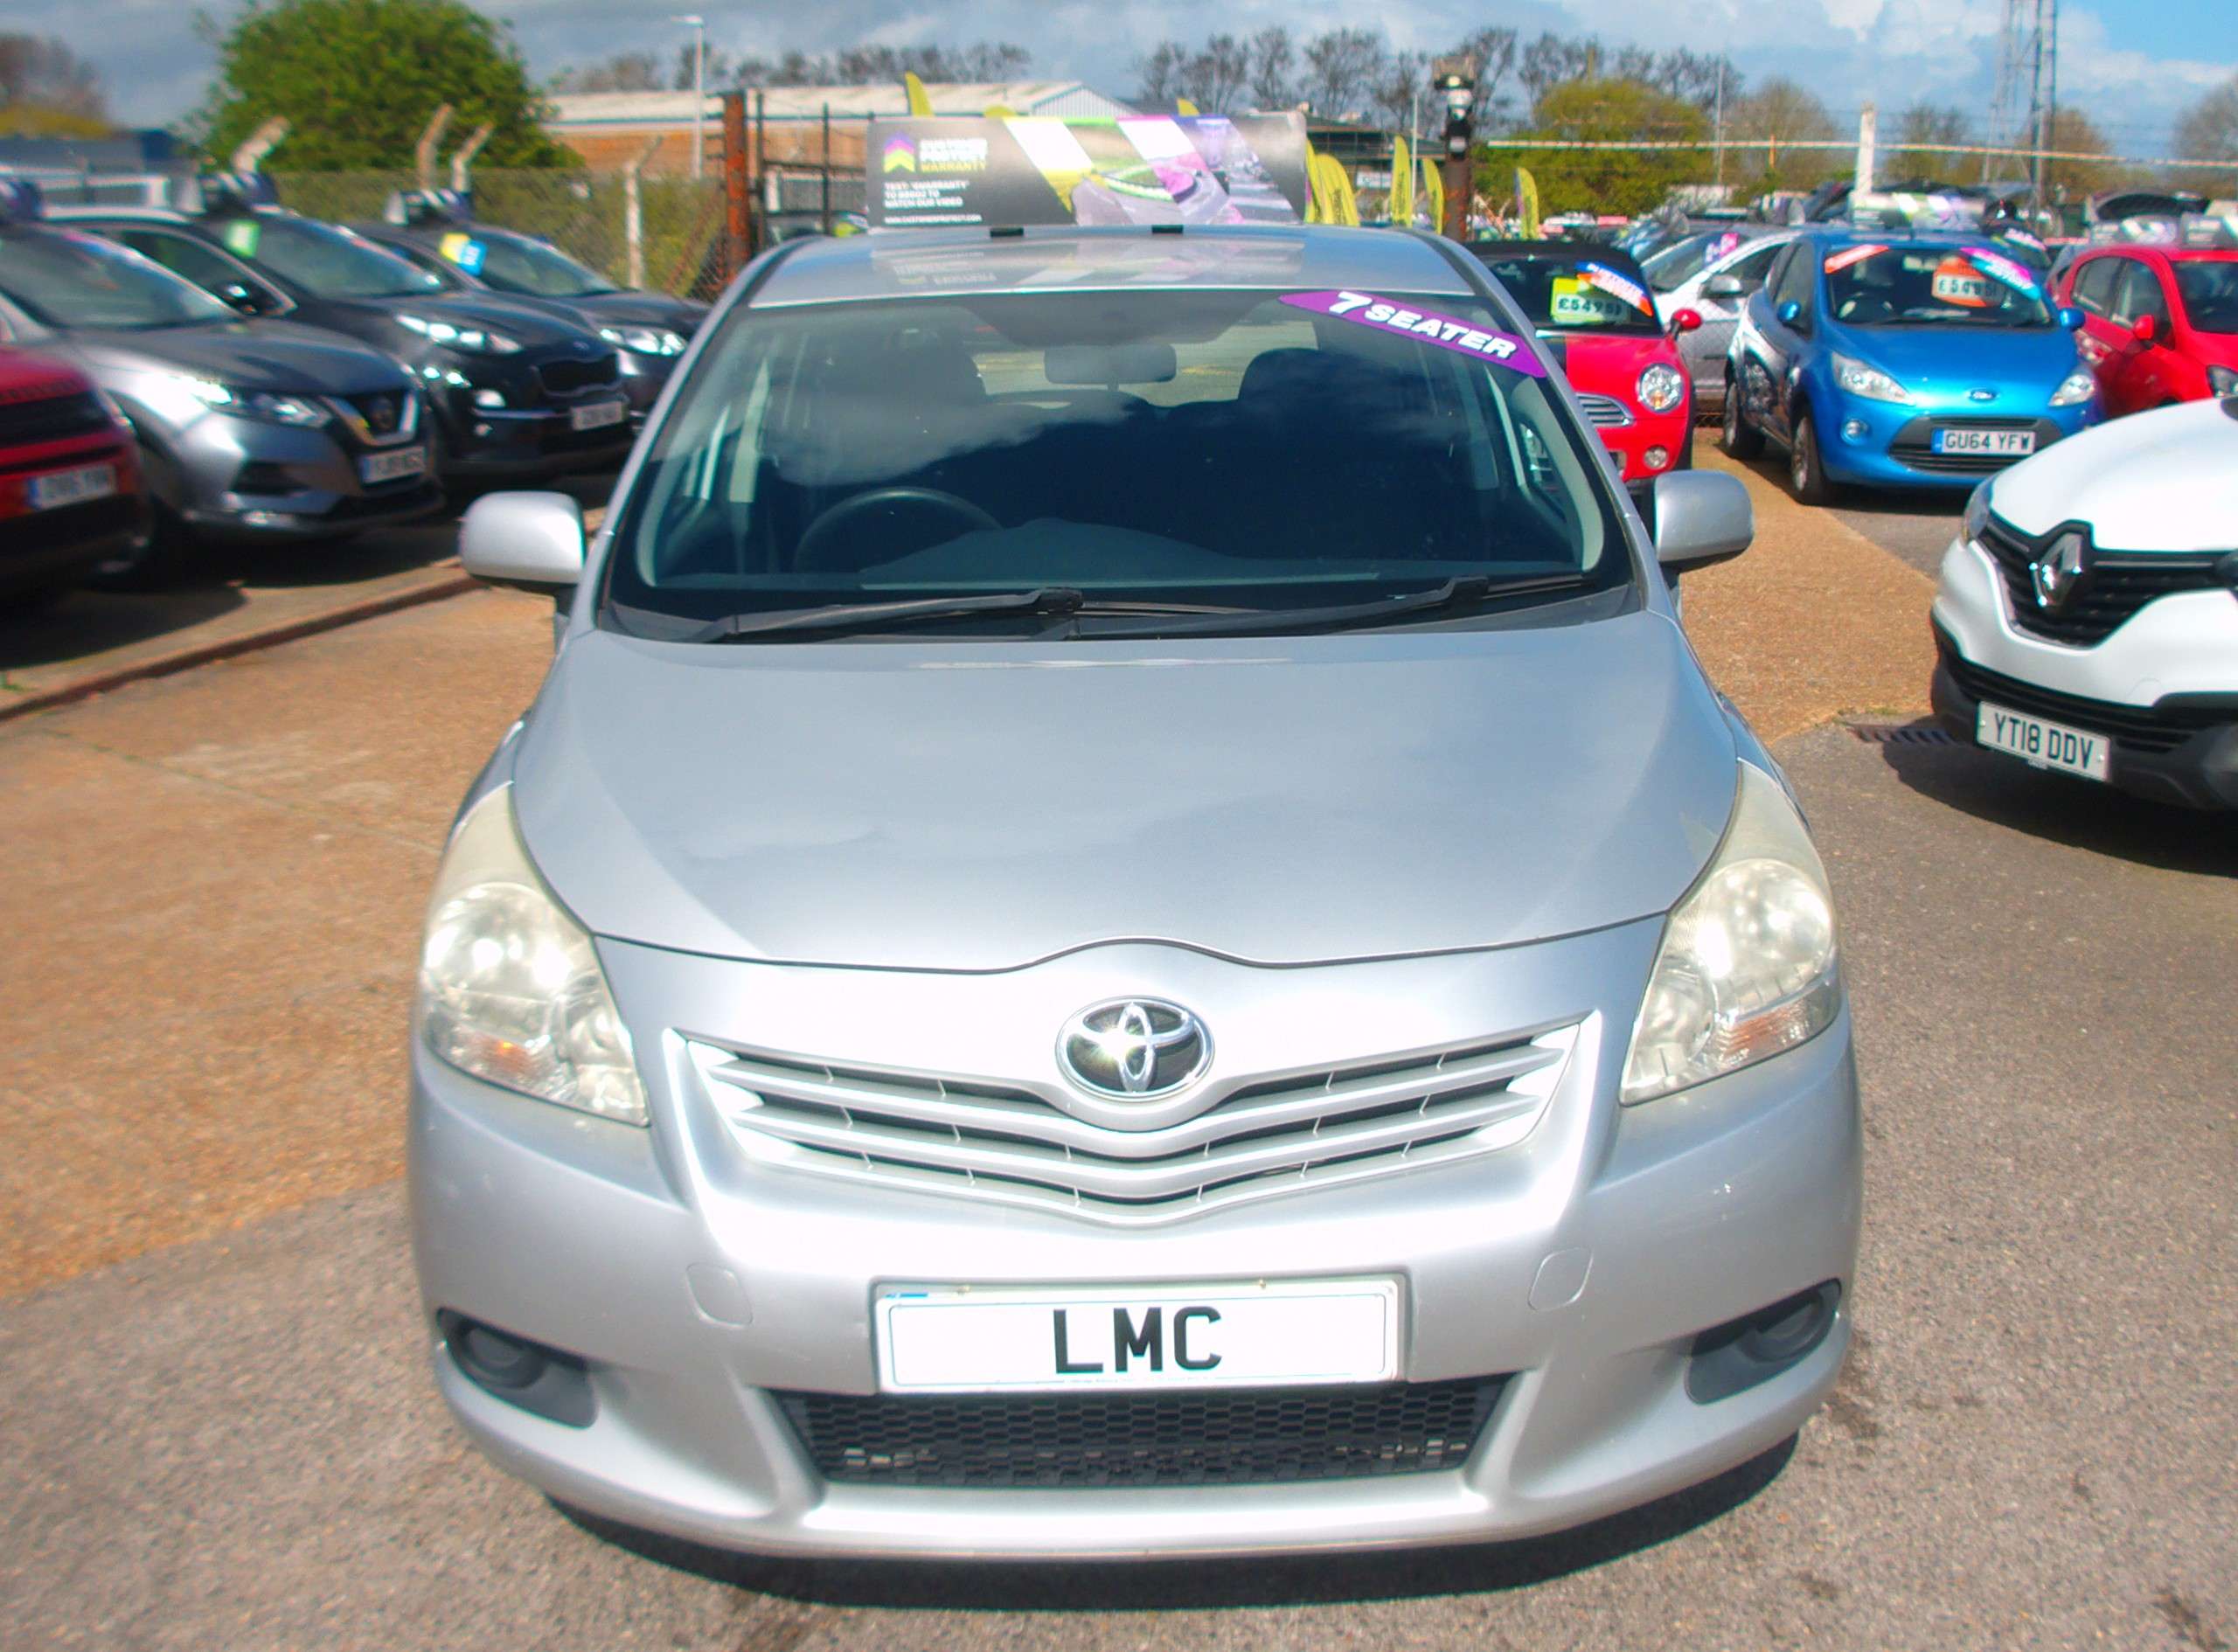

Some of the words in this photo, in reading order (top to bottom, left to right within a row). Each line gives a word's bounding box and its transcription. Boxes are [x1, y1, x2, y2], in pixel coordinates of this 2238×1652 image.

[921, 160, 986, 171] WARRANTY
[935, 197, 963, 206] VIDEO
[1328, 290, 1372, 316] 7
[1364, 303, 1518, 359] SEATER
[1946, 433, 1991, 449] GU64
[1998, 433, 2030, 450] YFW
[1994, 712, 2040, 754] YT18
[2047, 730, 2094, 770] DDV
[1052, 1306, 1223, 1375] LMC
